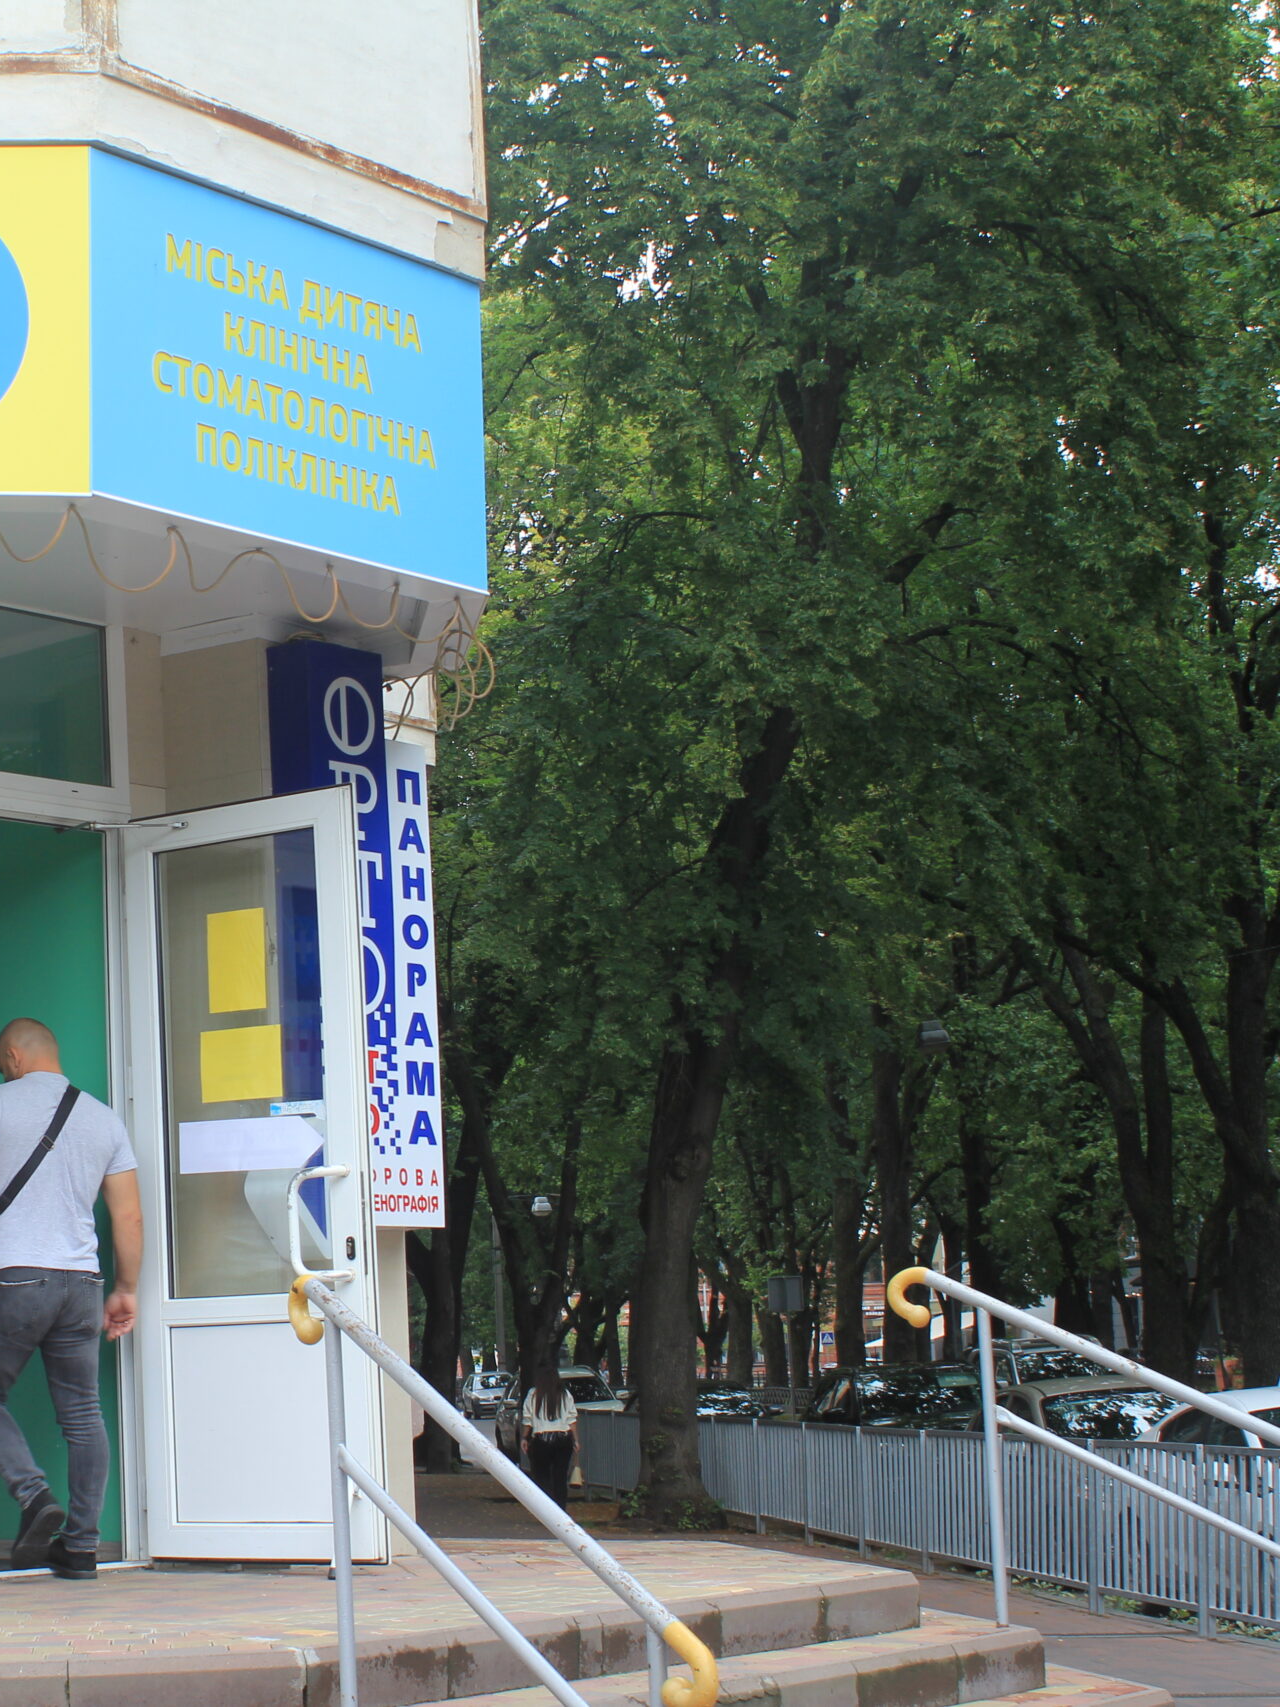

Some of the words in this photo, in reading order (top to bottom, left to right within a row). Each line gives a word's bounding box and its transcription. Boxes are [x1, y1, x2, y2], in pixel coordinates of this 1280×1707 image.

[166, 232, 289, 310] МІСЬКА
[298, 279, 422, 353] ДИТЯЧА
[151, 350, 436, 469] СТОМАТОЛОГІЧНА
[224, 311, 372, 394] КЛІНІЧНА
[196, 422, 401, 516] ПОЛІКЛІНІКА
[396, 768, 438, 1146] ПАНОРАМА
